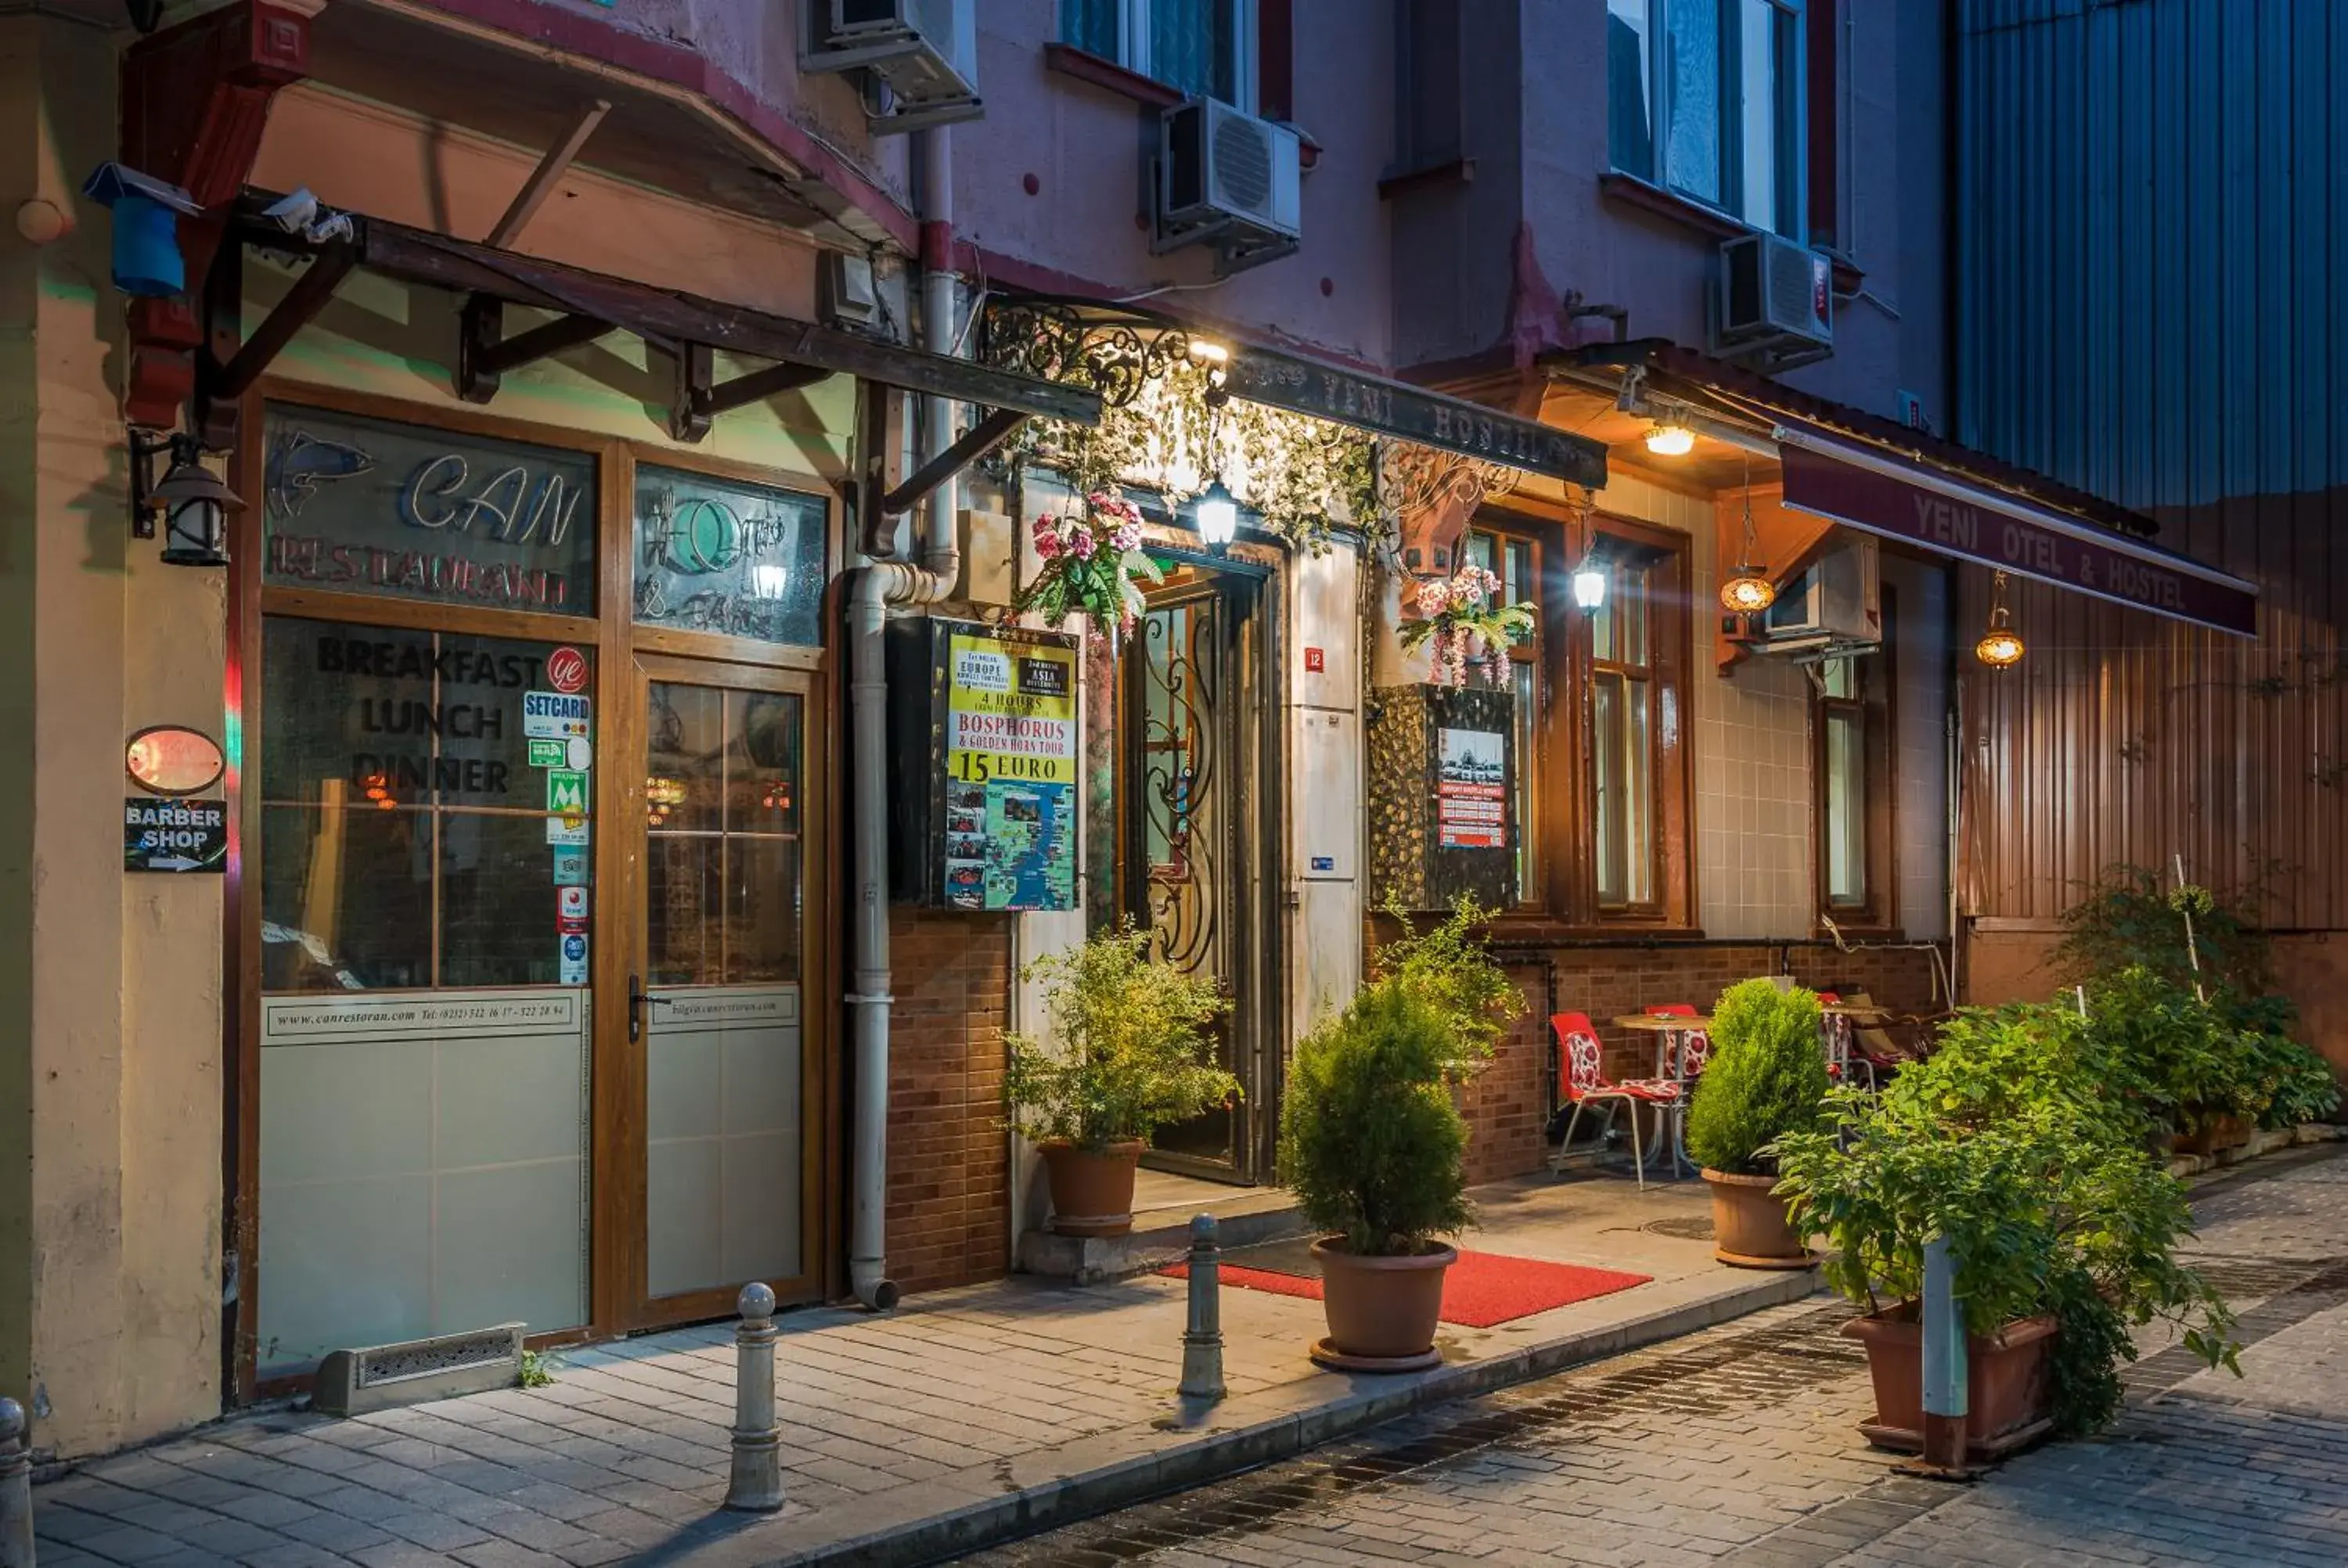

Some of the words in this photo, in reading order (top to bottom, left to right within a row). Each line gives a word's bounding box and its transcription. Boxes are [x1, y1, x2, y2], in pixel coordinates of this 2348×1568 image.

[412, 454, 582, 545] CAN
[2003, 524, 2063, 575] OTEL
[2079, 553, 2096, 585] &
[2109, 556, 2187, 610] HOSTEL
[317, 636, 543, 689] BREAKFAST
[960, 661, 1001, 677] EUROPE
[1032, 669, 1055, 682] ASIA
[525, 694, 589, 719] SETCARD
[981, 692, 989, 703] 4
[996, 693, 1043, 709] HOURS
[359, 696, 503, 739] LUNCH
[959, 713, 1065, 741] BOSPHORUS
[970, 735, 1008, 750] GOLDEN
[1010, 739, 1036, 753] HORN
[1039, 741, 1064, 755] TOUR
[351, 751, 509, 794] DINNER
[960, 752, 989, 782] 15
[998, 756, 1057, 779] EURO
[126, 807, 221, 827] BARBER
[143, 830, 207, 848] SHOP
[277, 1010, 416, 1026] www.canrestoran.com
